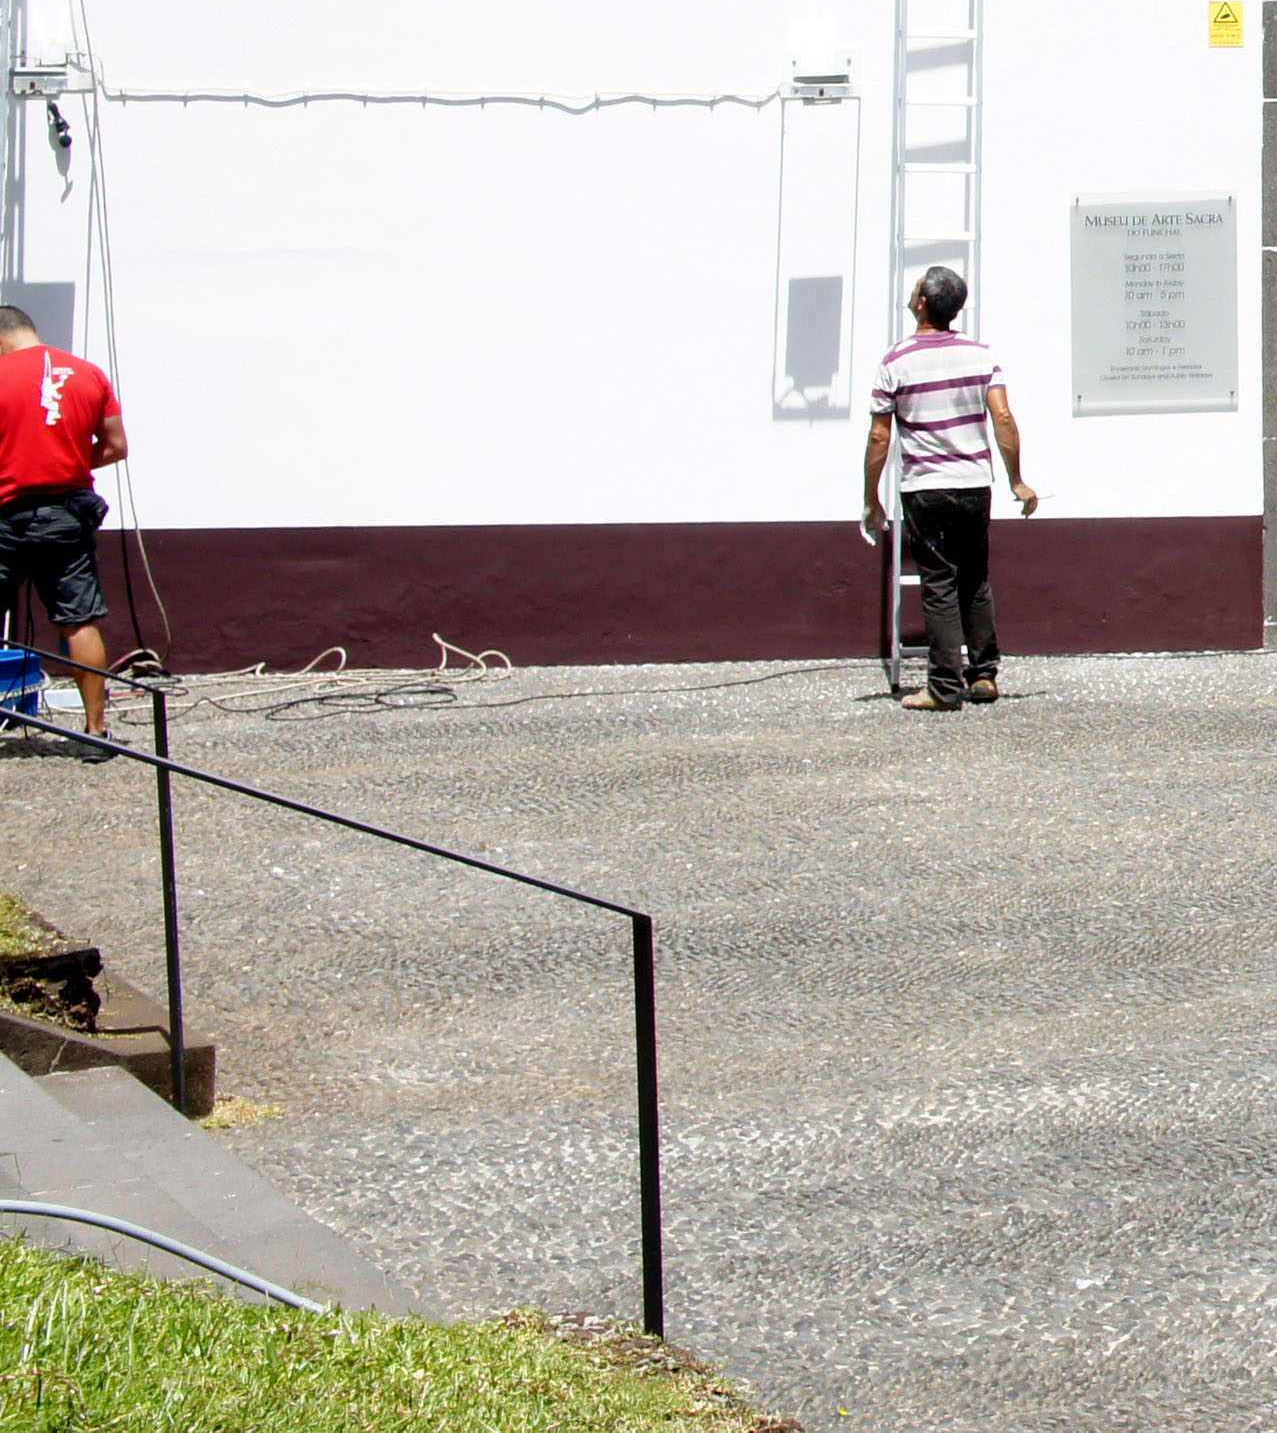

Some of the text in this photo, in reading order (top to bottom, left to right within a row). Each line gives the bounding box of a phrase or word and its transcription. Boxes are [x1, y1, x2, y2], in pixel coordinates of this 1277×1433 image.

[1085, 212, 1223, 226] MUSEU DE ARTE SACRA
